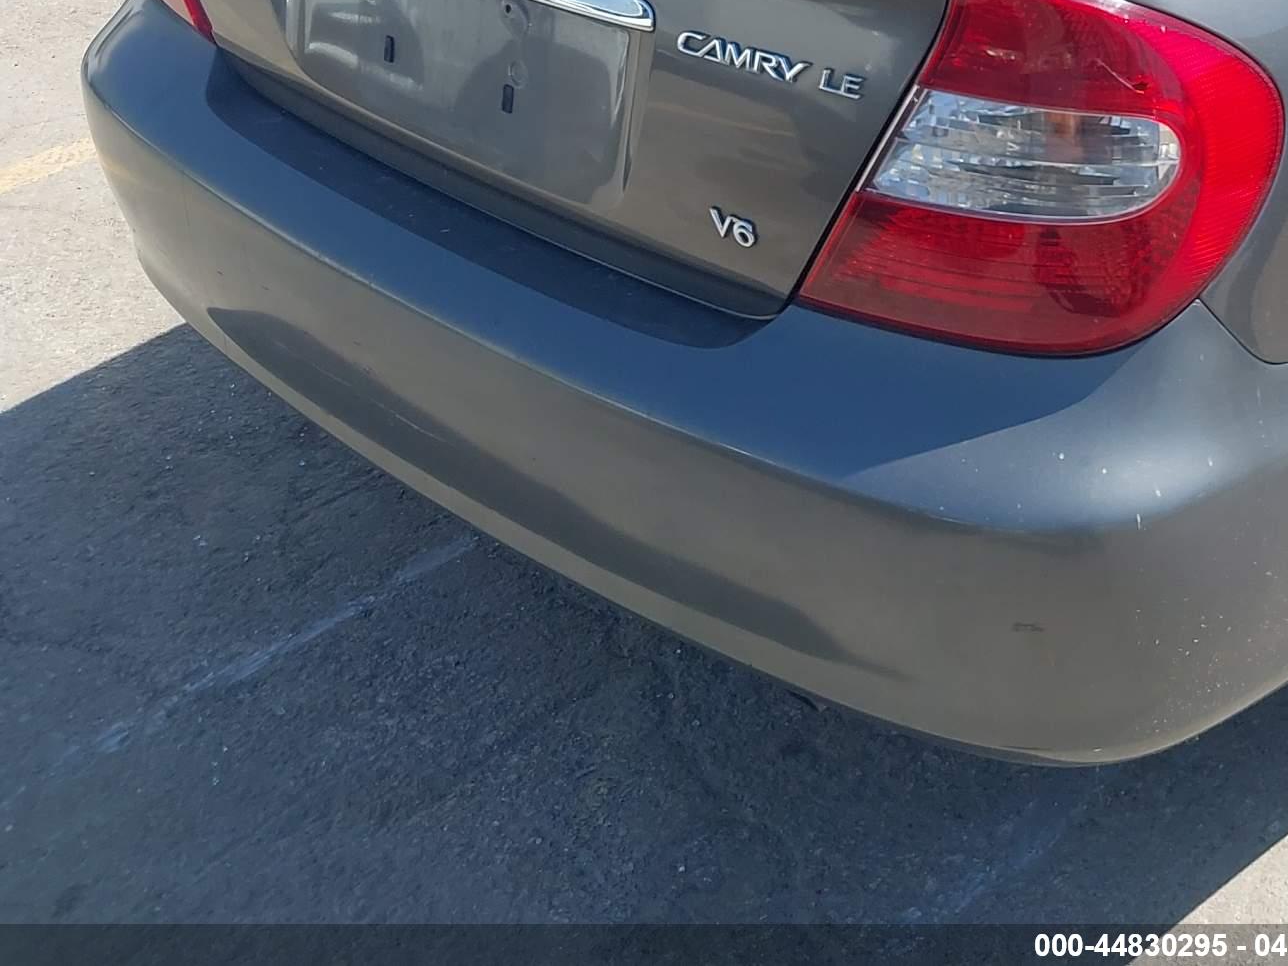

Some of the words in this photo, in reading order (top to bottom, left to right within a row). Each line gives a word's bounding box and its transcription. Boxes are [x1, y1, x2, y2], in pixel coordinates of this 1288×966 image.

[677, 31, 811, 82] CAMRY
[818, 69, 866, 99] LE
[709, 207, 756, 247] V6
